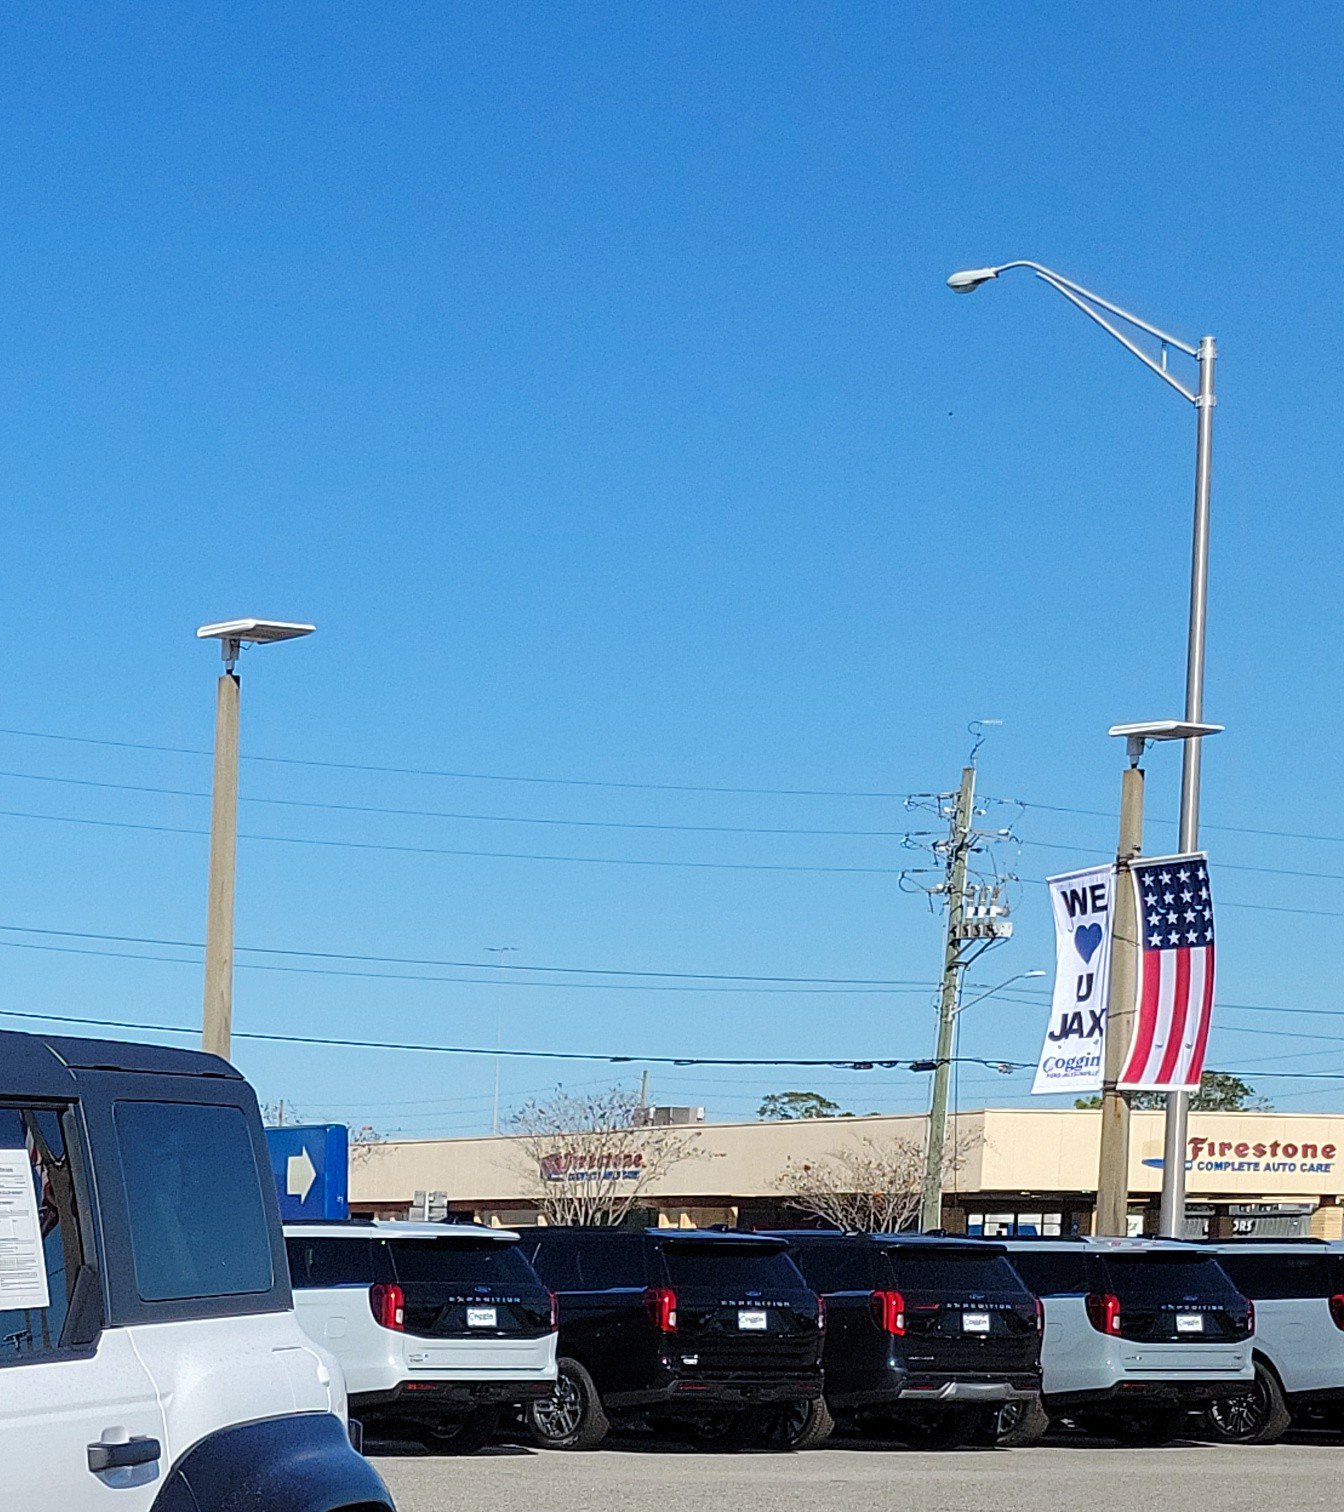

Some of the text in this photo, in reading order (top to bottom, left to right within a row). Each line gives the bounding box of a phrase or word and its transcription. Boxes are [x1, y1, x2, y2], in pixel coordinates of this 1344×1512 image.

[1061, 883, 1108, 918] WE
[1076, 973, 1094, 1002] U
[1048, 1008, 1107, 1042] JAX
[1043, 1052, 1100, 1073] Coggin
[1188, 1137, 1337, 1161] Firestone
[1197, 1161, 1332, 1173] COMPLETE AUTO CARE
